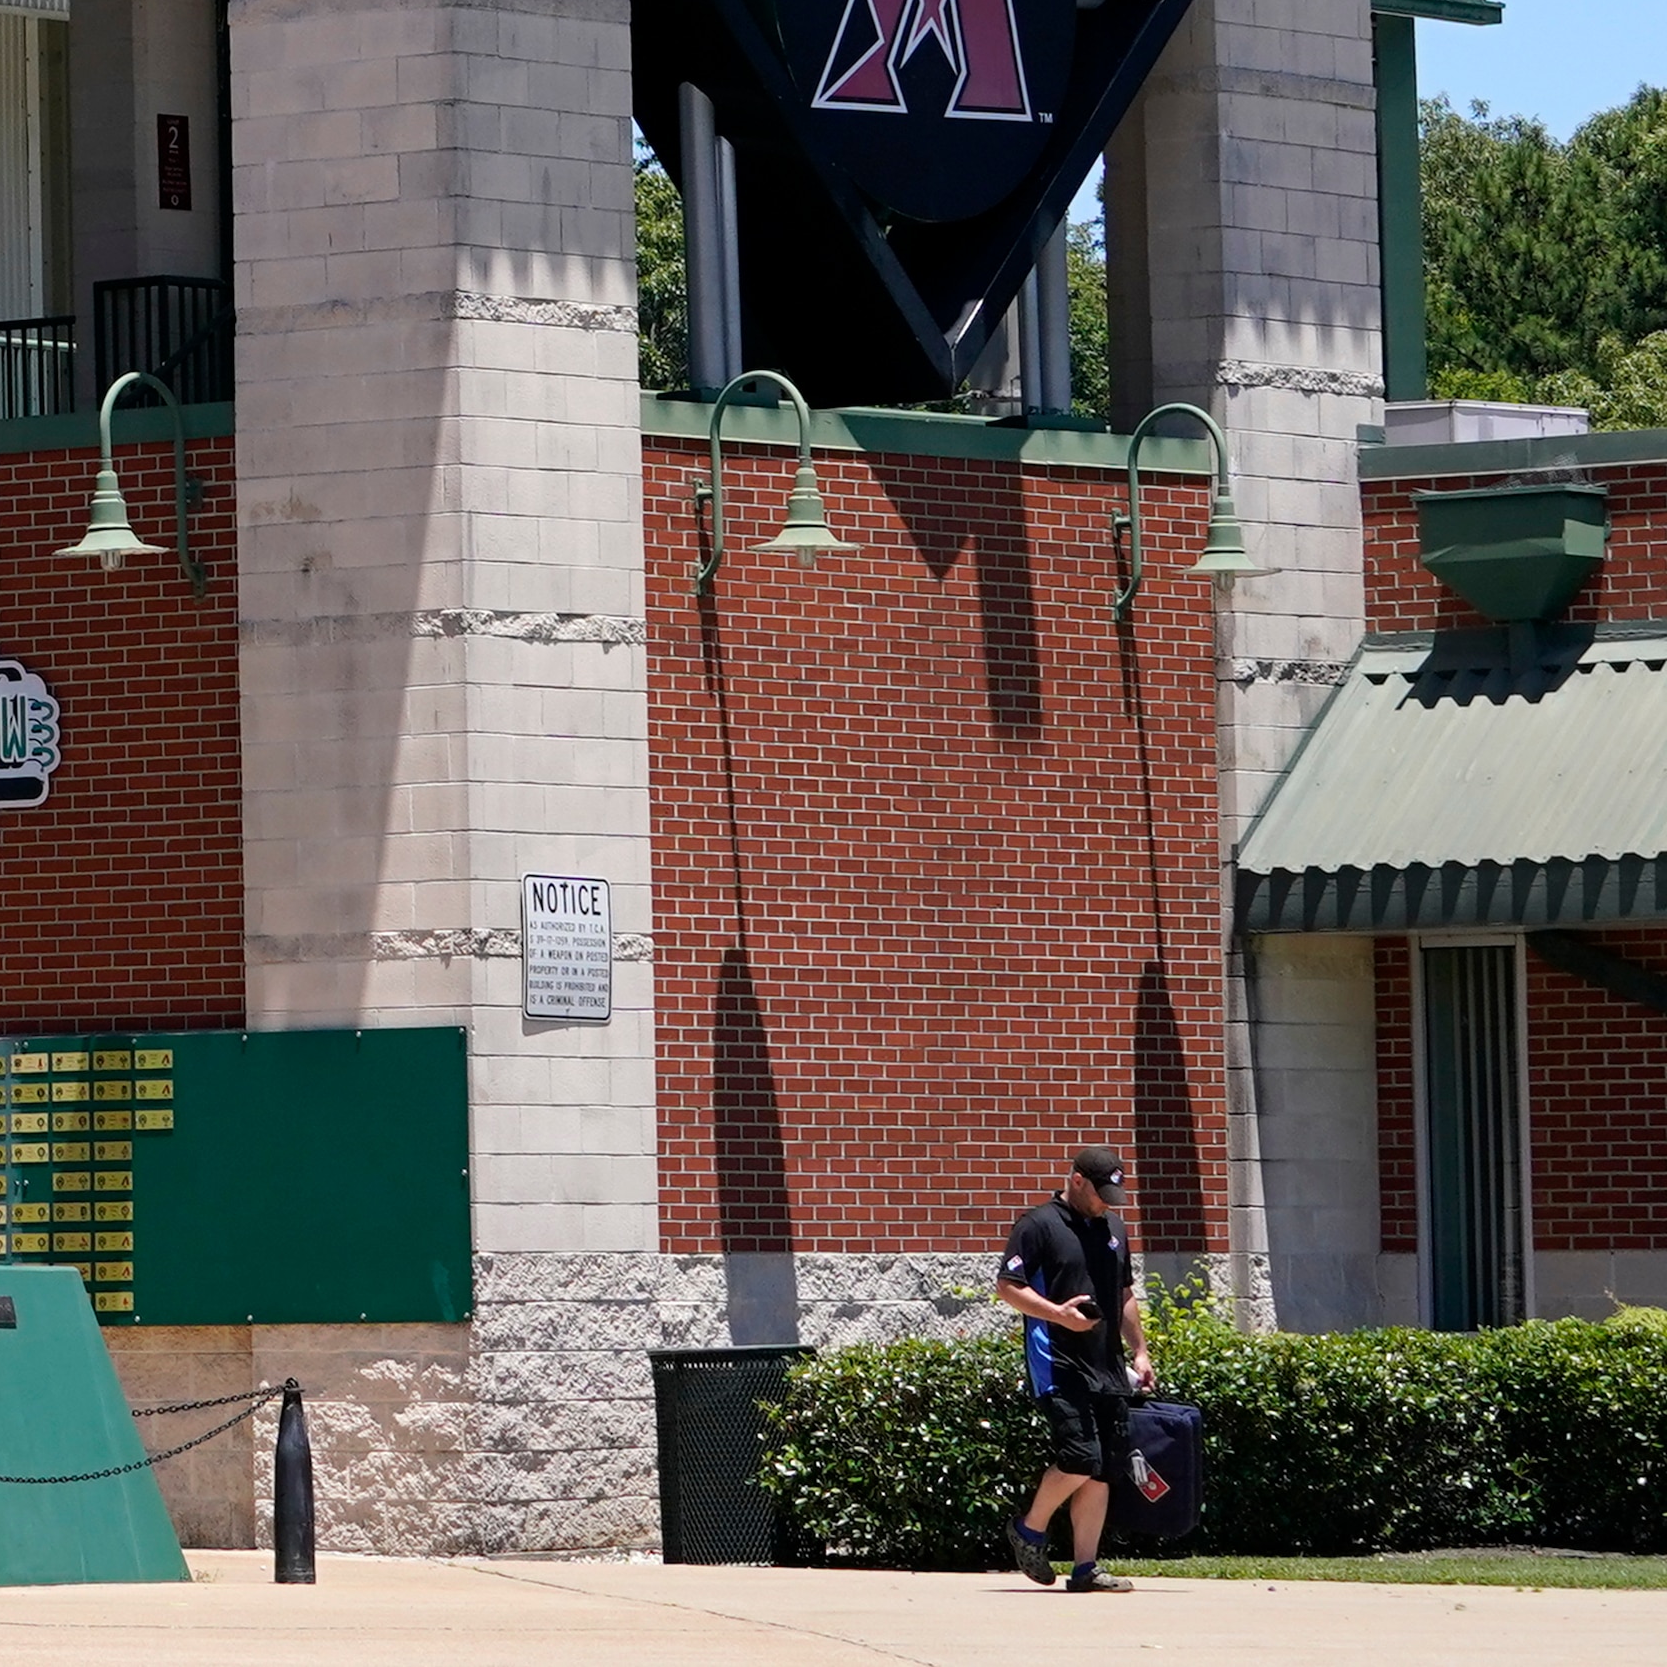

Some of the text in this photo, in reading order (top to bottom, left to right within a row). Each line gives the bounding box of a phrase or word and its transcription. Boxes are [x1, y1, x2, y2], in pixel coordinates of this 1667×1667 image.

[1038, 112, 1054, 123] TM
[168, 125, 179, 149] 2
[533, 882, 601, 916] NOTICE
